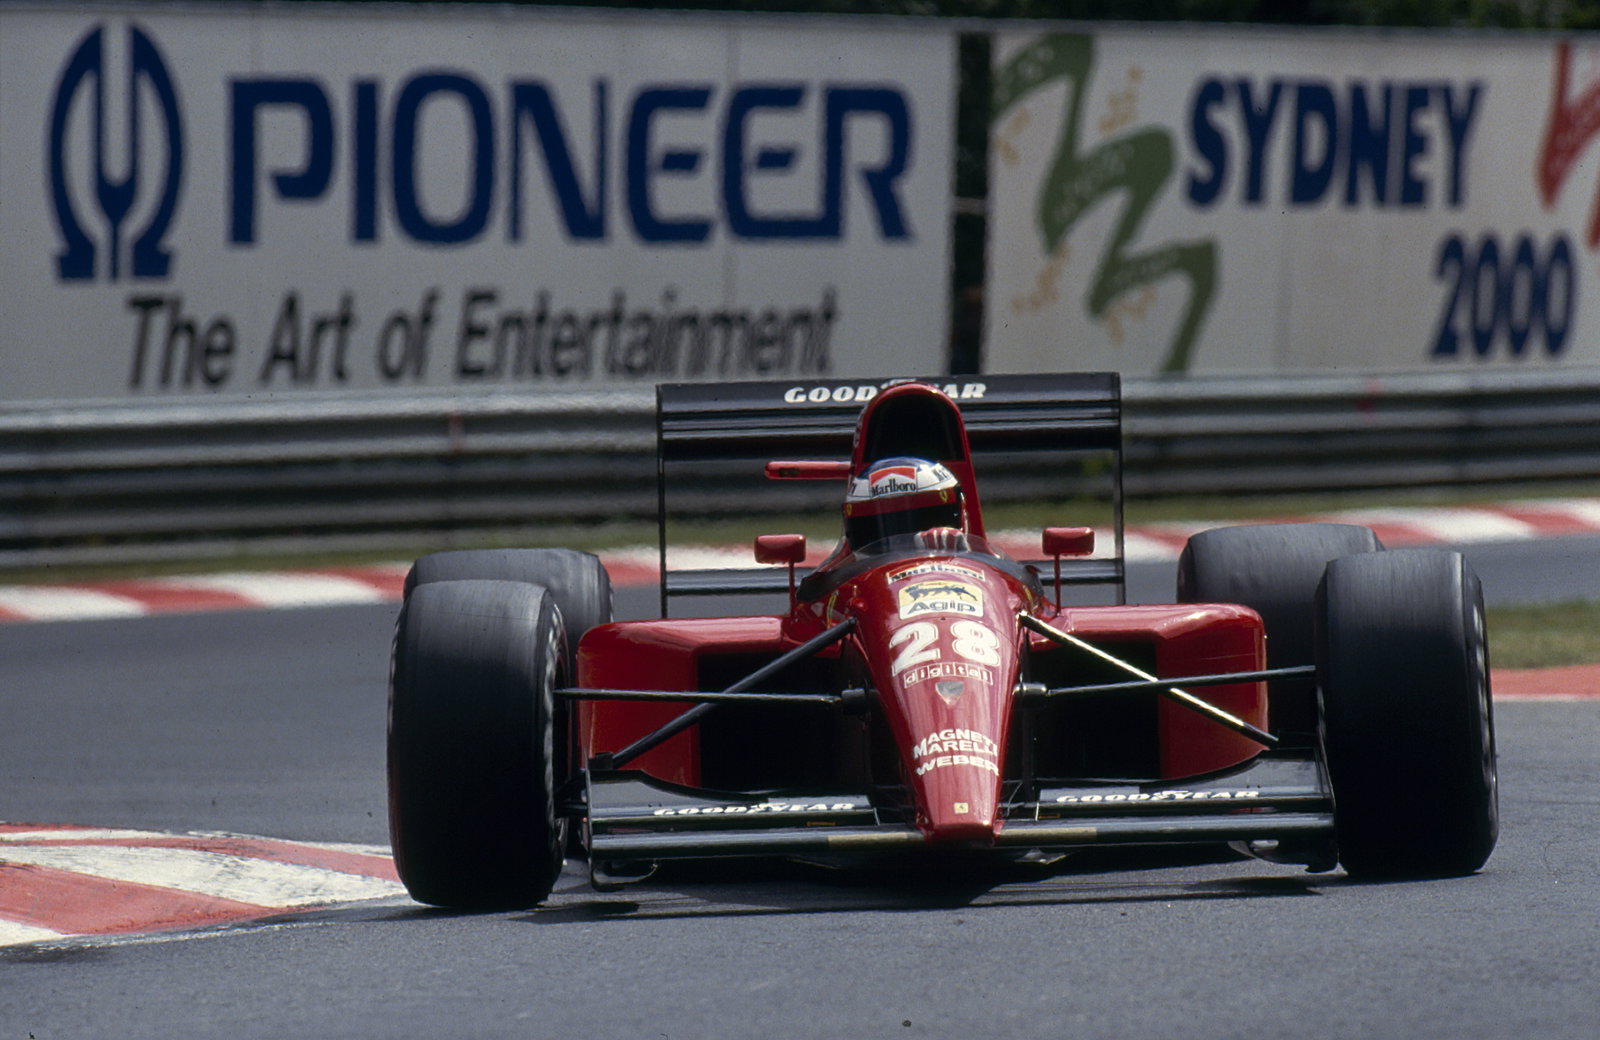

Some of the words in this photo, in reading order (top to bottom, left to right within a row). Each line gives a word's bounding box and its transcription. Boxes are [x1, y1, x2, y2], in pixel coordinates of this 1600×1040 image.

[228, 71, 914, 246] PIONEER
[1187, 75, 1485, 209] SYDNEY
[1430, 230, 1577, 359] 2000
[127, 293, 237, 388] The
[258, 289, 356, 384] Art
[378, 288, 441, 382] of
[454, 287, 839, 380] Entertainment
[784, 382, 987, 403] GOODAR
[870, 478, 917, 496] Marlboro
[907, 601, 976, 615] Agip
[889, 620, 1000, 677] 28
[904, 662, 993, 688] digital
[916, 755, 999, 776] WEBER
